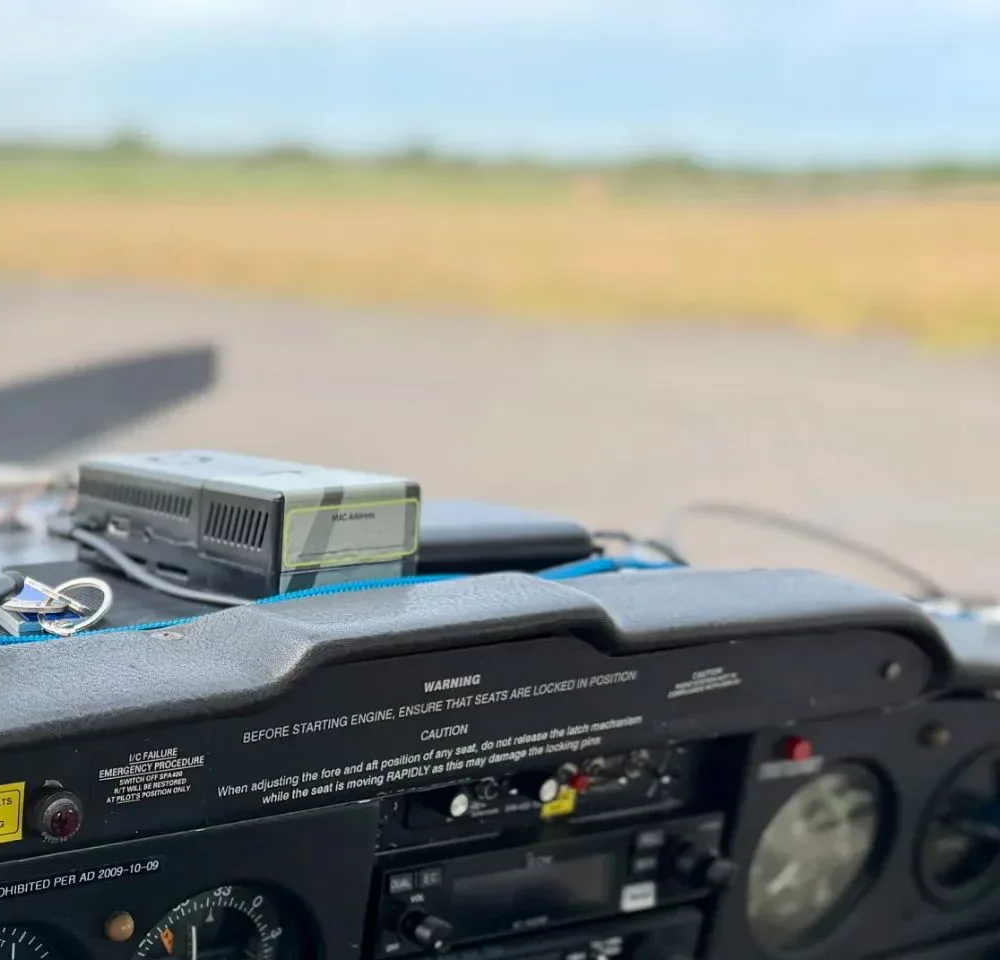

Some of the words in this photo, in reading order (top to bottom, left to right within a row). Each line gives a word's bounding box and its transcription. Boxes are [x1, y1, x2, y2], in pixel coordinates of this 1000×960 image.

[331, 512, 348, 522] MAC
[348, 511, 376, 520] Address
[424, 674, 481, 693] WARNING
[242, 726, 290, 744] BEFORE
[292, 716, 348, 735] STARTING
[350, 708, 395, 726] ENGINE,
[398, 700, 442, 718] ENSURE
[446, 697, 473, 710] THAT
[474, 690, 508, 706] SEATS
[509, 686, 532, 700] ARE
[532, 679, 576, 697] LOCKED
[576, 678, 588, 690] IN
[589, 670, 638, 688] POSITION
[420, 724, 469, 741] CAUTION
[128, 752, 142, 763] I/C
[143, 748, 178, 762] FAILURE
[218, 784, 248, 798] When
[250, 771, 299, 793] adjusting
[302, 770, 318, 782] the
[321, 766, 341, 780] fore
[343, 762, 364, 774] and
[366, 759, 380, 772] aft
[381, 752, 420, 772] position
[422, 750, 434, 762] of
[434, 750, 454, 766] any
[455, 744, 478, 758] seat,
[481, 740, 494, 751] do
[496, 738, 512, 750] not
[513, 729, 548, 746] release
[550, 726, 565, 739] the
[566, 722, 590, 736] latch
[590, 714, 643, 734] mechanism
[99, 765, 152, 780] EMERGENCY
[154, 756, 204, 771] PROCEDURE
[262, 792, 290, 805] while
[292, 788, 308, 800] the
[311, 784, 334, 796] seat
[335, 781, 344, 792] is
[346, 774, 384, 792] moving
[386, 765, 430, 783] RAPIDLY
[432, 765, 444, 774] as
[446, 760, 464, 772] this
[465, 758, 487, 774] may
[488, 750, 526, 768] damage
[528, 747, 544, 758] the
[545, 741, 580, 758] locking
[580, 736, 602, 752] pins
[119, 776, 144, 786] SWITCH
[146, 774, 158, 782] OFF
[125, 784, 140, 792] WILL
[141, 782, 150, 790] BE
[152, 778, 187, 790] RESTORED
[106, 796, 116, 804] AT
[142, 788, 170, 799] POSITION
[52, 874, 76, 886] PER
[78, 871, 96, 883] AD
[97, 860, 160, 880] 2009-10-09
